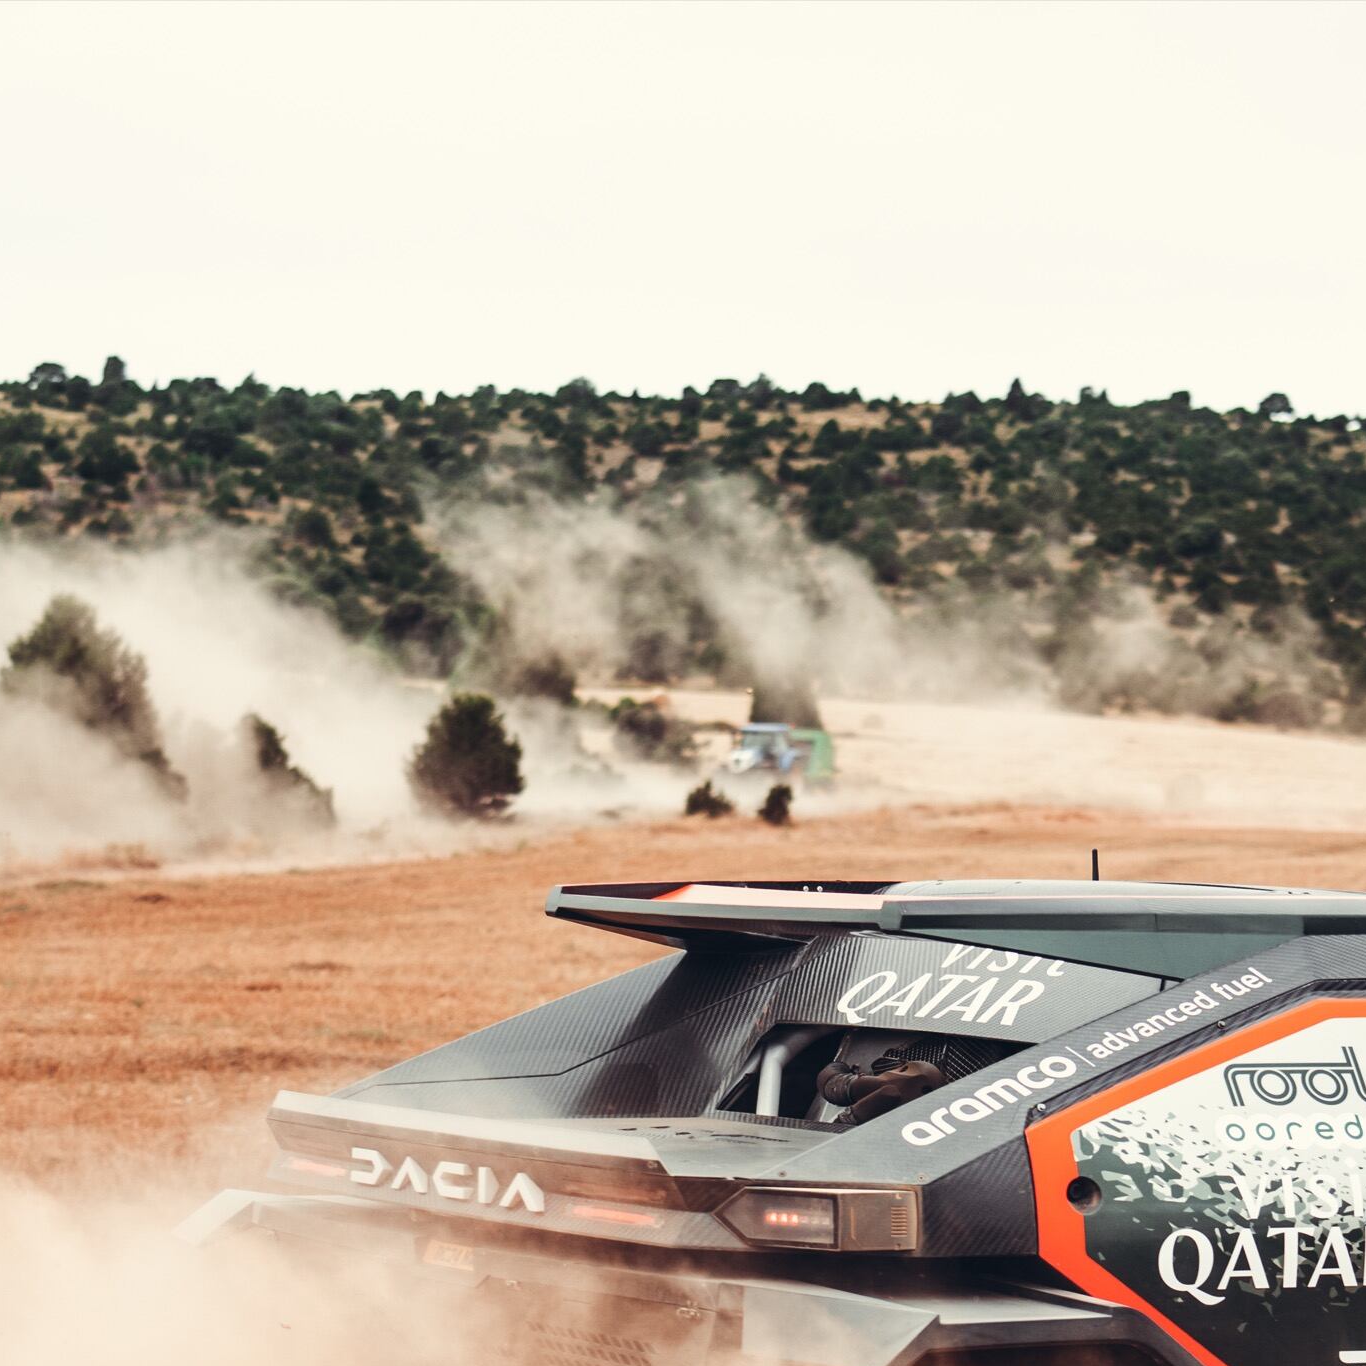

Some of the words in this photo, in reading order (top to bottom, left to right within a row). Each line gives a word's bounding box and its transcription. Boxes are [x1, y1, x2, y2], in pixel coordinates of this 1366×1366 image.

[837, 971, 1045, 1025] QATAR
[901, 1056, 1077, 1147] aramco
[1086, 991, 1219, 1060] advanced
[1213, 966, 1274, 1001] fuel
[349, 1147, 545, 1212] DACIA
